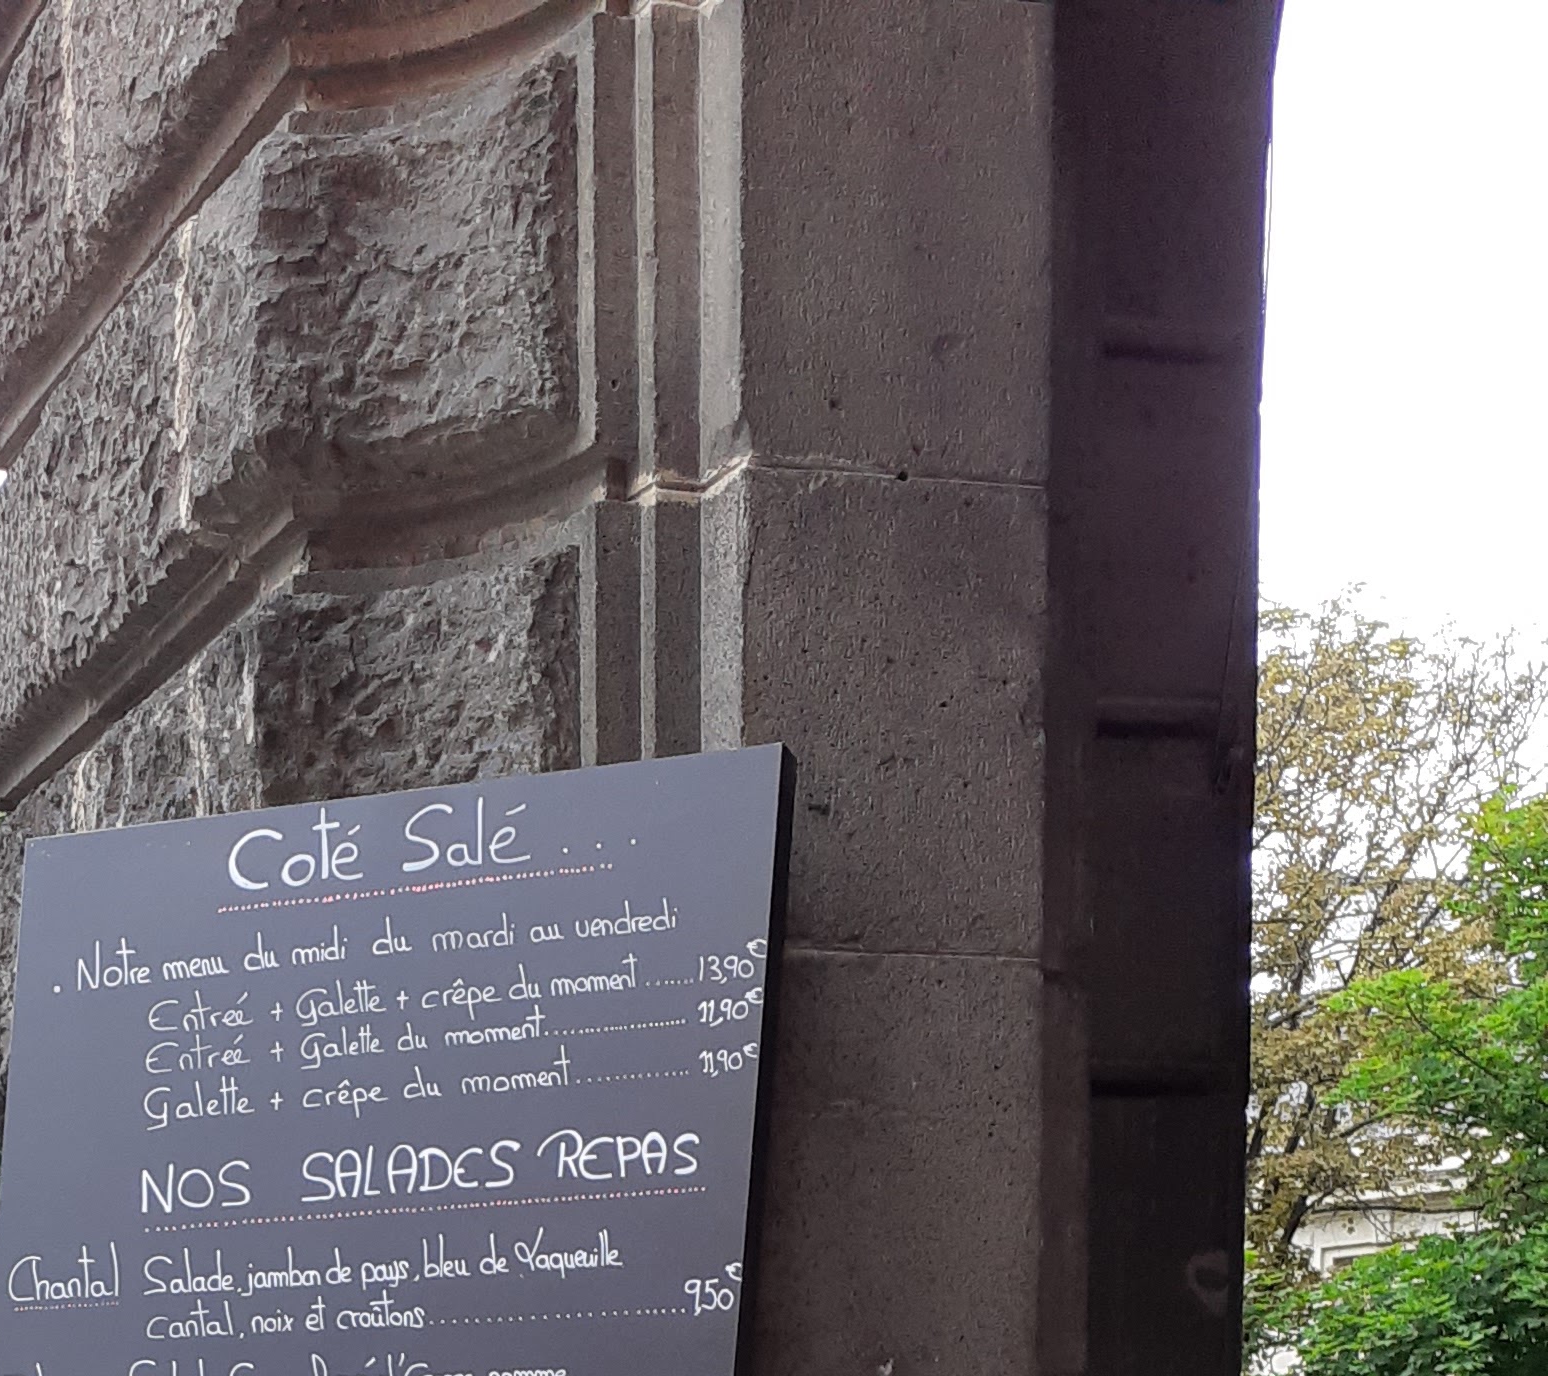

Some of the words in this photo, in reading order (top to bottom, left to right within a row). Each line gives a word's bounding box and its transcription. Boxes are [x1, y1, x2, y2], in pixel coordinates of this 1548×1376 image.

[228, 807, 363, 889] Coté
[77, 937, 151, 991] Notre
[162, 952, 229, 980] menu
[243, 931, 280, 971] du
[292, 924, 348, 965] midi
[372, 916, 412, 956] du
[431, 912, 516, 952] mardi
[530, 923, 565, 944] au
[575, 897, 680, 938] vendredi
[296, 979, 387, 1026] Galette
[421, 978, 501, 1020] crêpe
[508, 963, 542, 1001] du
[550, 953, 638, 996] moment
[300, 1023, 384, 1069] Galette
[397, 1022, 428, 1051] du
[445, 1004, 546, 1046] moment
[144, 1075, 255, 1130] Galette
[303, 1079, 388, 1118] crêpe
[403, 1066, 442, 1099] du
[461, 1044, 571, 1094] moment
[141, 1160, 251, 1213] NOS
[301, 1141, 521, 1203] SALADES
[537, 1128, 700, 1180] REPAS
[8, 1241, 119, 1301] Chantal
[241, 1246, 322, 1296] jambon
[325, 1247, 352, 1284] de
[423, 1234, 471, 1278] bleu
[479, 1232, 509, 1274] de
[252, 1308, 294, 1334] noix
[305, 1296, 326, 1331] et
[336, 1290, 425, 1331] croûtons
